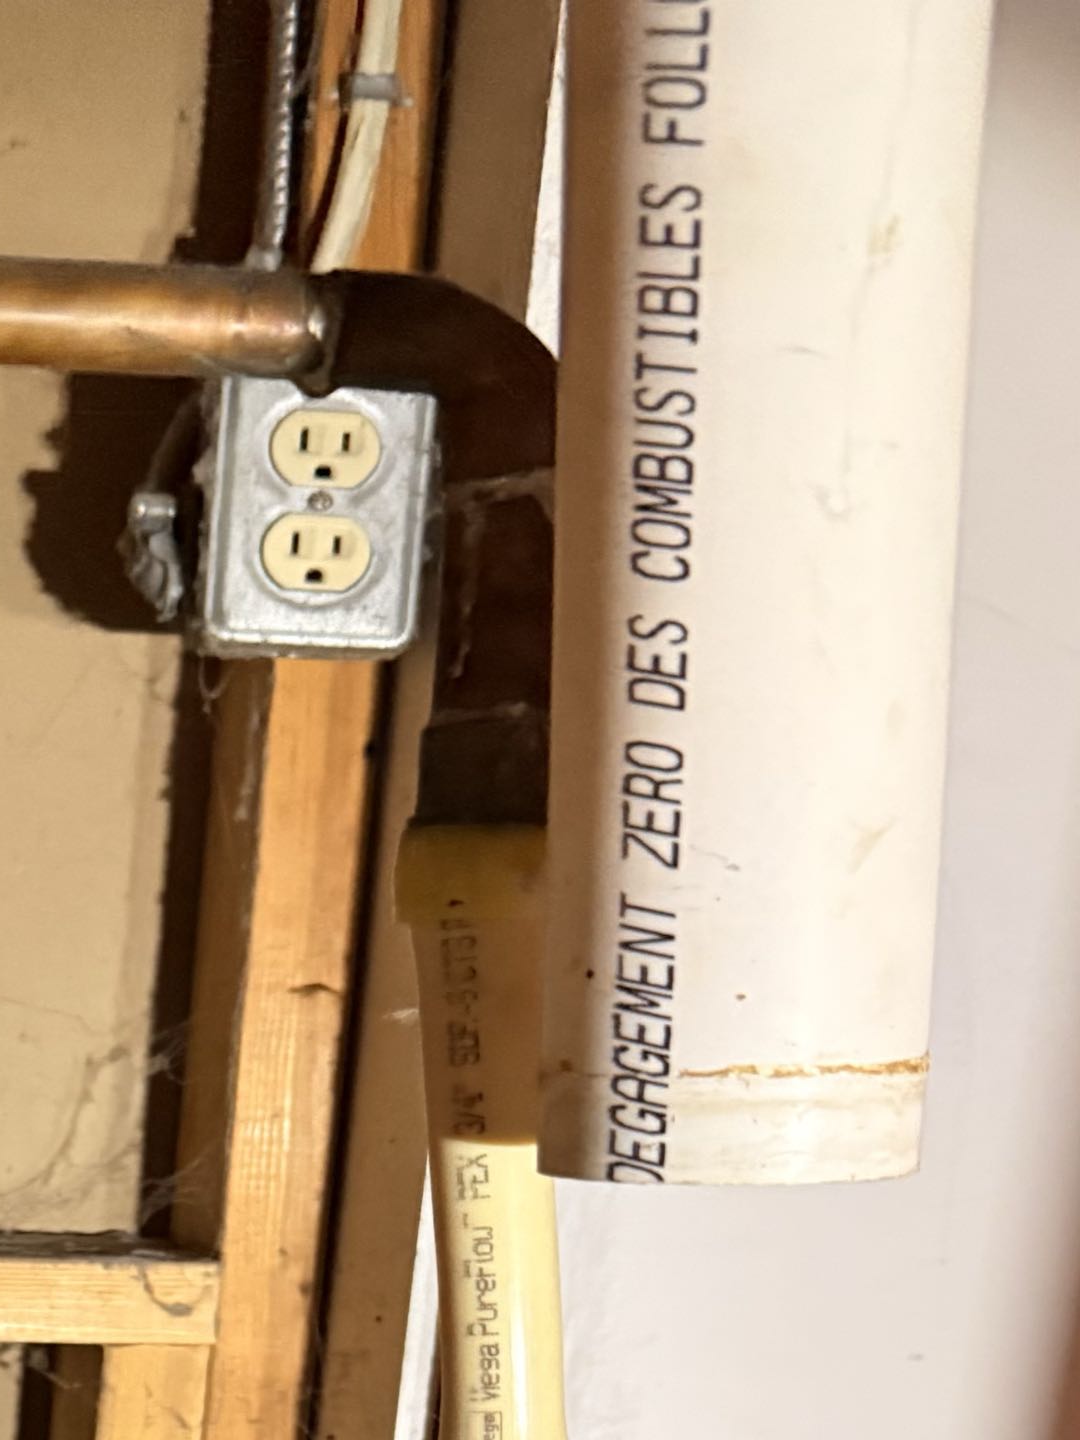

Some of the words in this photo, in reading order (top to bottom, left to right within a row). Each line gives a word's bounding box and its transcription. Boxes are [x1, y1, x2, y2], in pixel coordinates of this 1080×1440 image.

[642, 0, 711, 147] FOLL
[630, 182, 703, 583] COMBUSTIBLES
[626, 613, 689, 712] DES
[622, 740, 684, 871] ZERO
[456, 1153, 492, 1201] PEX
